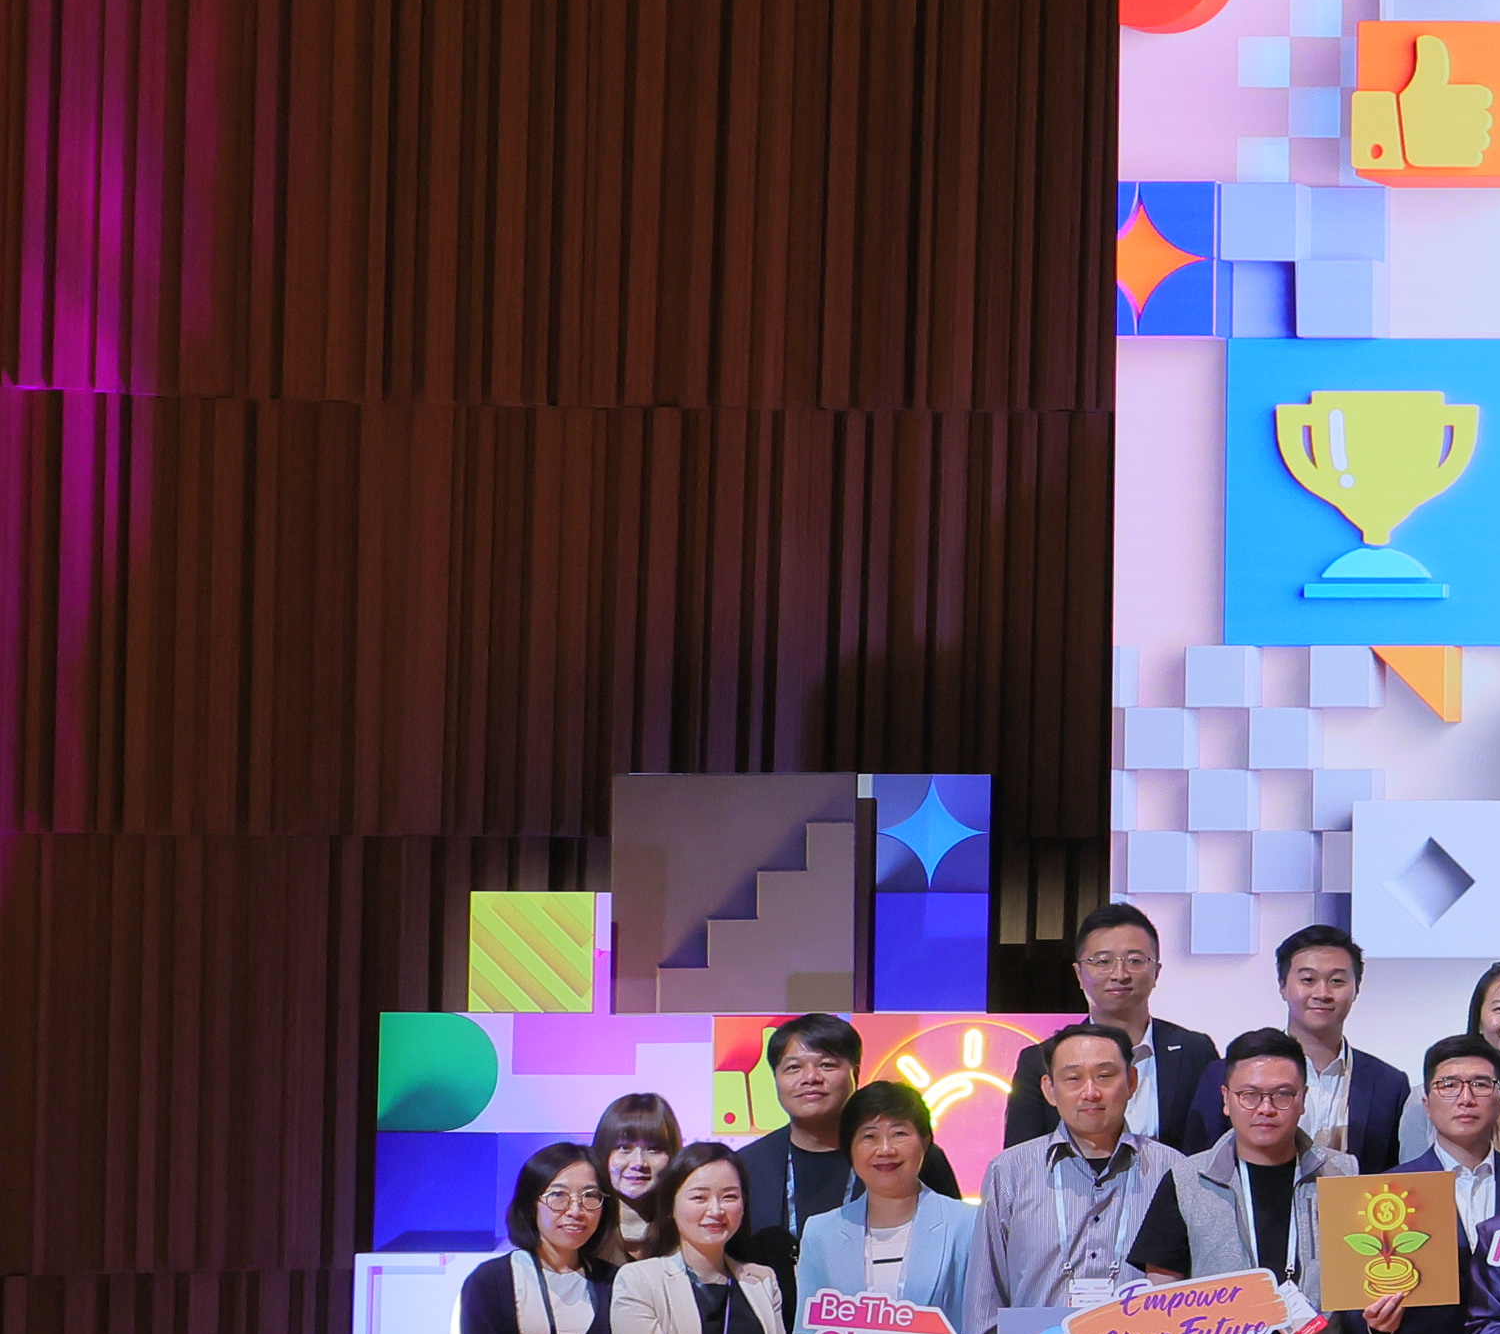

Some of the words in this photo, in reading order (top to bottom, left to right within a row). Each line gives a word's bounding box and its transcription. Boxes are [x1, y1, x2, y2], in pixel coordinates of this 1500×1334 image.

[820, 1294, 855, 1323] Be
[859, 1298, 914, 1327] The
[1119, 1281, 1244, 1319] Empower
